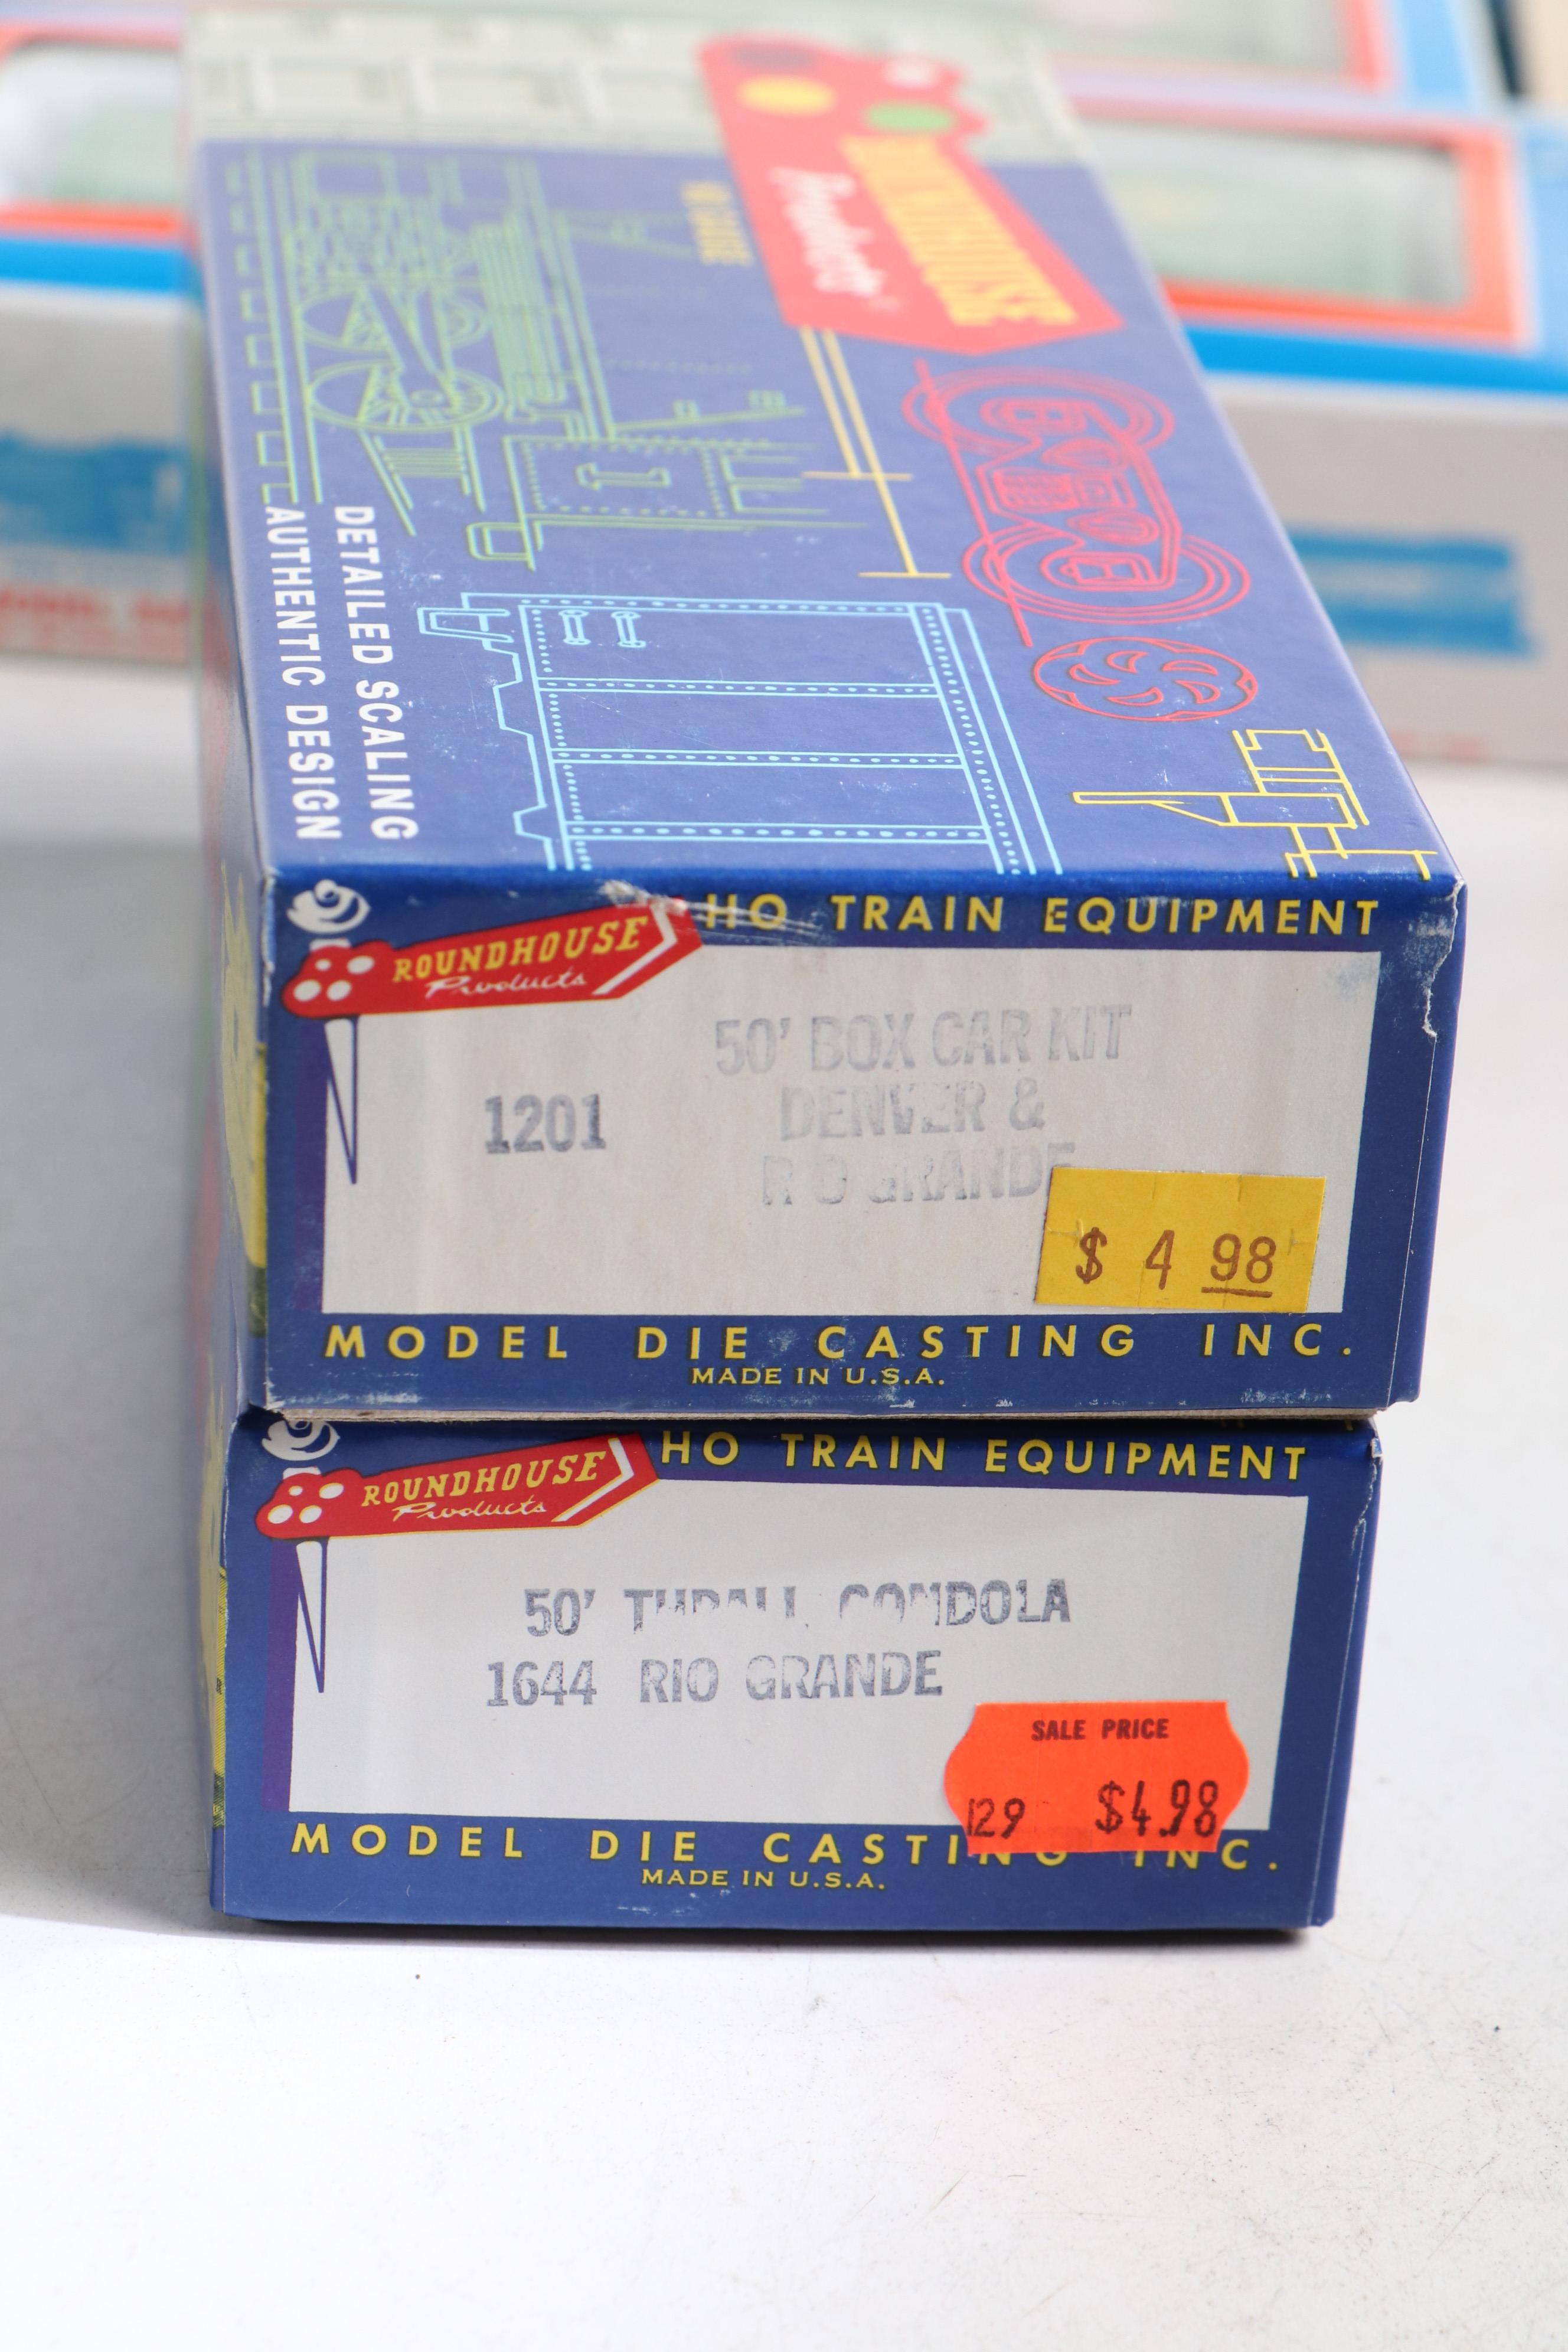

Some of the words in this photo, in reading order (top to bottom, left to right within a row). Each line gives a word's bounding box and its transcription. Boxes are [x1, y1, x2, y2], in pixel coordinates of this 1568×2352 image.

[265, 506, 326, 686] AUTHENTIC
[334, 505, 394, 664] DETAILED
[286, 705, 342, 839] DESIGN
[355, 680, 419, 839] SCALING
[705, 893, 788, 929] HO
[830, 895, 1002, 932] TRAIN
[1044, 896, 1378, 935] EQUIPMENT
[394, 916, 649, 983] ROUNDHOUSE
[425, 970, 586, 999] Products
[715, 1017, 792, 1076] 50'
[811, 1013, 916, 1071] BOX
[932, 1010, 1031, 1066] CAR
[1048, 1004, 1132, 1062] KIT
[485, 1093, 607, 1155] 1201
[1009, 1077, 1046, 1131] &
[1077, 1227, 1108, 1285] $
[1145, 1229, 1175, 1291] 4
[1210, 1233, 1278, 1285] 98
[325, 1324, 567, 1359] MODEL
[637, 1326, 746, 1360] DIE
[818, 1324, 1133, 1360] CASTING
[1203, 1322, 1352, 1357] INC.
[692, 1367, 780, 1386] MADE
[796, 1367, 828, 1386] IN
[845, 1367, 945, 1386] U.S.A.
[362, 1451, 608, 1508] ROUNDHOUSE
[661, 1430, 739, 1466] HO
[781, 1433, 945, 1471] TRAIN
[985, 1439, 1306, 1481] EQUIPMENT
[392, 1495, 547, 1522] Products
[524, 1587, 596, 1637] 50'
[486, 1659, 597, 1707] 1644
[640, 1657, 720, 1704] RIO
[746, 1649, 943, 1701] GRANDE
[1032, 1719, 1086, 1741] SALE
[1102, 1717, 1170, 1740] PRICE
[1096, 1780, 1219, 1838] $4.98
[291, 1822, 523, 1858] MODEL
[590, 1830, 696, 1862] DIE
[641, 1868, 729, 1886] MADE
[742, 1870, 774, 1887] IN
[789, 1870, 886, 1889] U.S.A.
